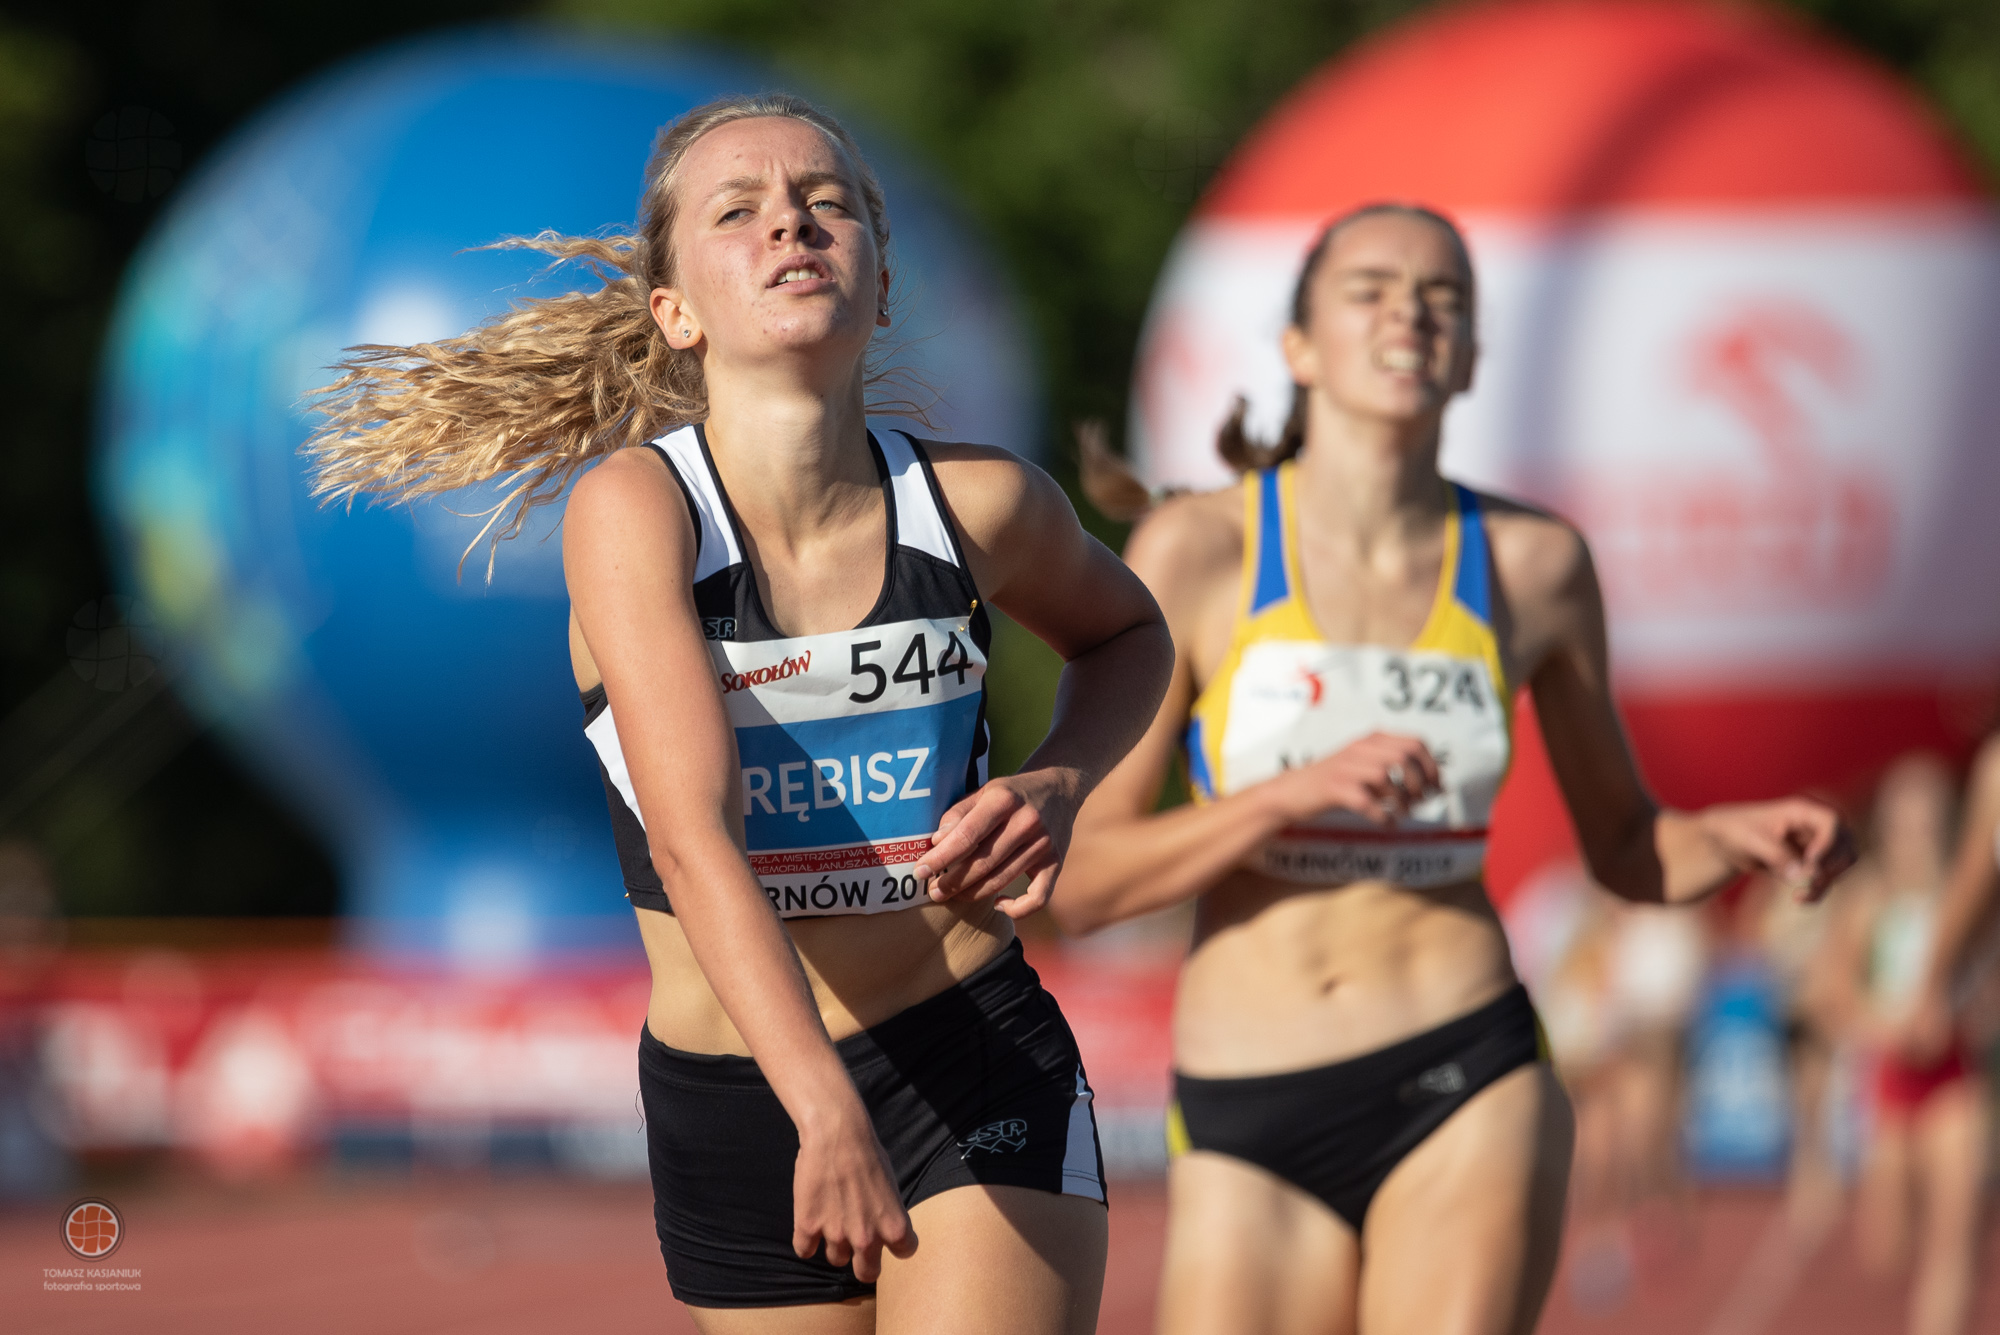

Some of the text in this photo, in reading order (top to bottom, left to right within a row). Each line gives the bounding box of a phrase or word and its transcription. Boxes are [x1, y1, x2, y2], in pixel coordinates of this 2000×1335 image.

[721, 650, 811, 694] SOKOŁÓW
[848, 631, 974, 704] 544
[1382, 656, 1487, 714] 324
[742, 747, 931, 823] RĘBISZ
[754, 850, 928, 875] MEMORIAŁ JANUSZA KUSOCIŃS
[783, 848, 864, 863] MISTRZOSTWA
[867, 841, 907, 855] POLSKI
[908, 840, 927, 851] U16
[765, 868, 942, 911] RNÓW 201
